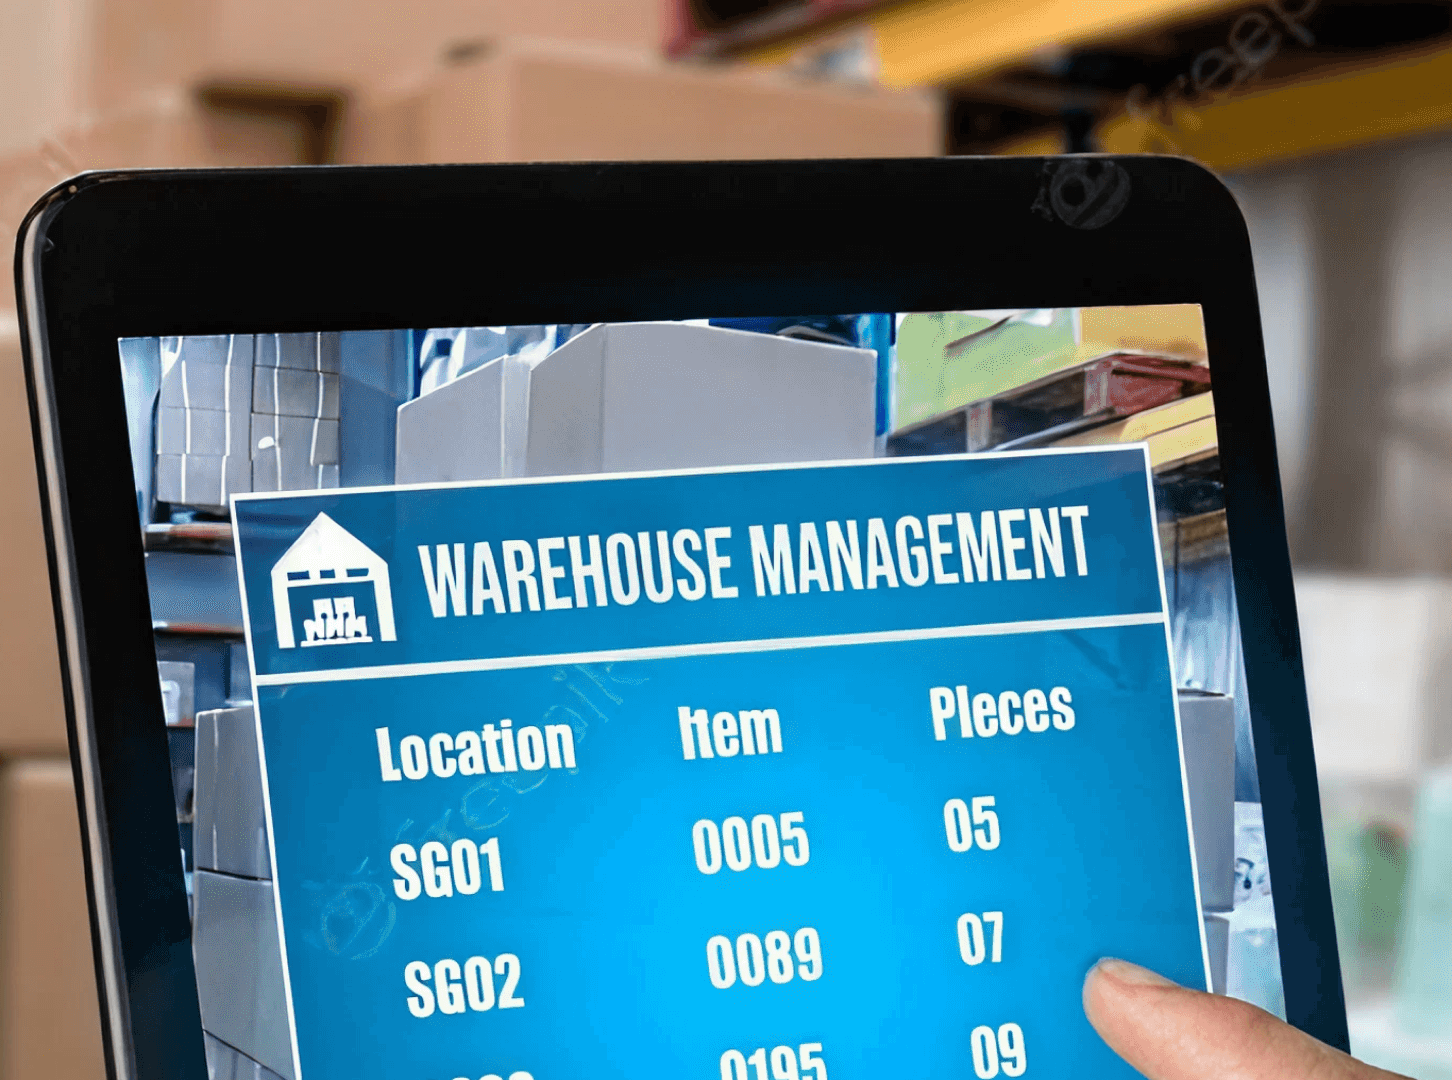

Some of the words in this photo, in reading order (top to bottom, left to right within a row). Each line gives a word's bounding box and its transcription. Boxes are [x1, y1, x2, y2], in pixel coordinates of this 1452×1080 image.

[417, 526, 739, 618] WAREHOUSE
[748, 505, 1089, 597] MANAGEMENT
[375, 719, 577, 782] Location
[677, 706, 783, 760] Item
[390, 837, 505, 901] SG01
[692, 811, 810, 875] 0005
[943, 795, 1001, 853] 05
[404, 953, 525, 1018] SG02
[706, 927, 823, 989] 0089
[957, 911, 1003, 966] 07
[970, 1022, 1027, 1080] 09
